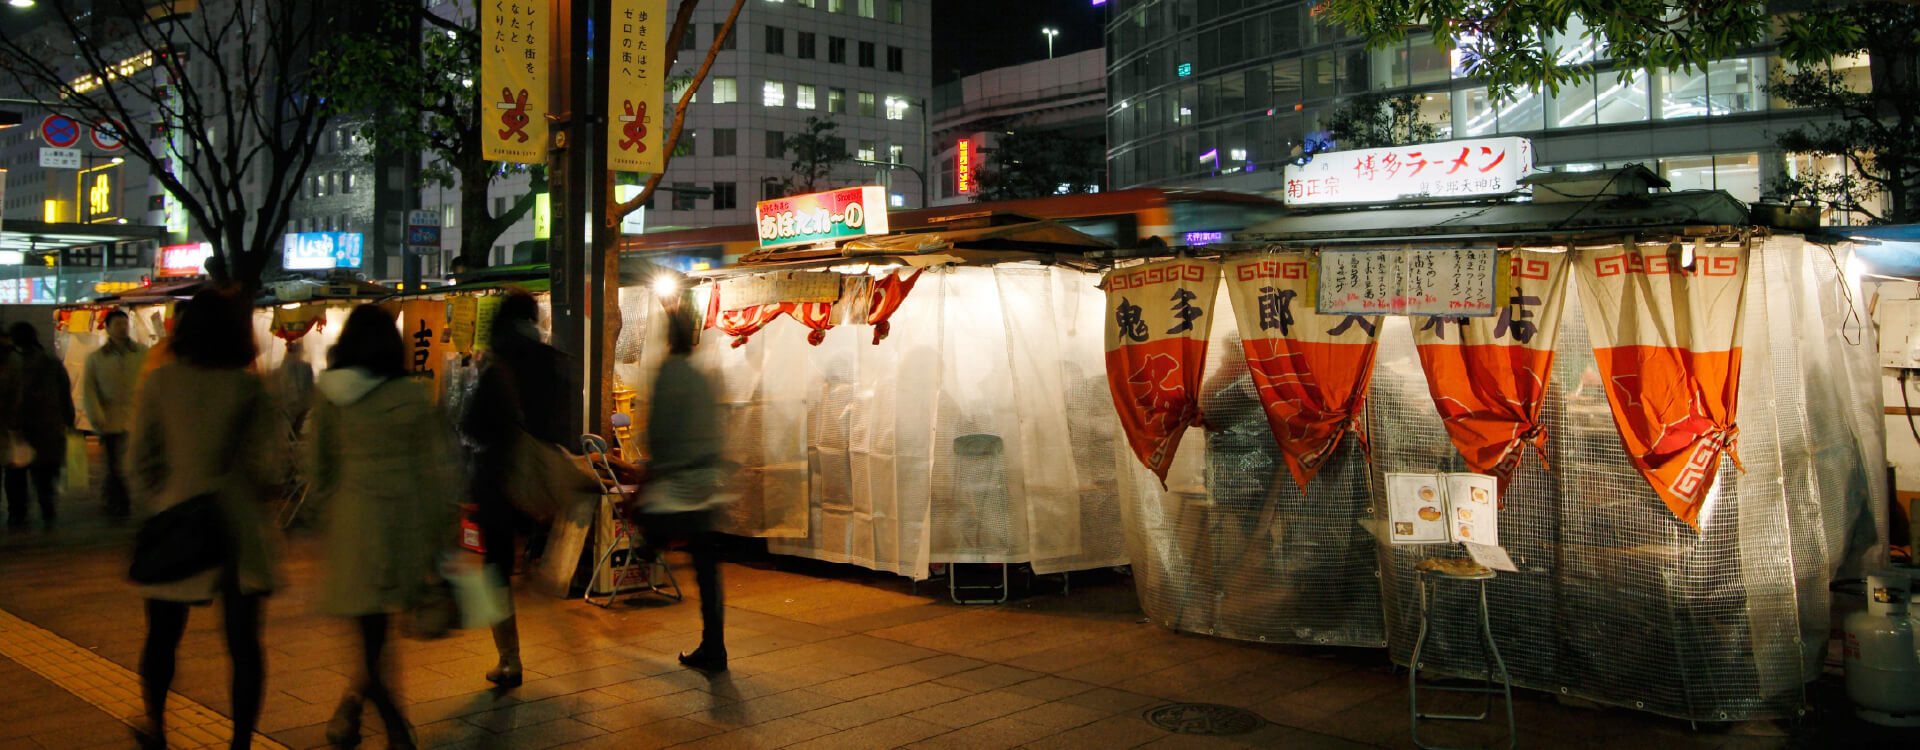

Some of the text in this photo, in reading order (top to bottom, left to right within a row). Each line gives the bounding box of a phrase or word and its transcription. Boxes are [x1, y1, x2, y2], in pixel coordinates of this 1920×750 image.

[1353, 146, 1506, 181] 博多ラーメン
[1287, 176, 1340, 199] 菊正宗
